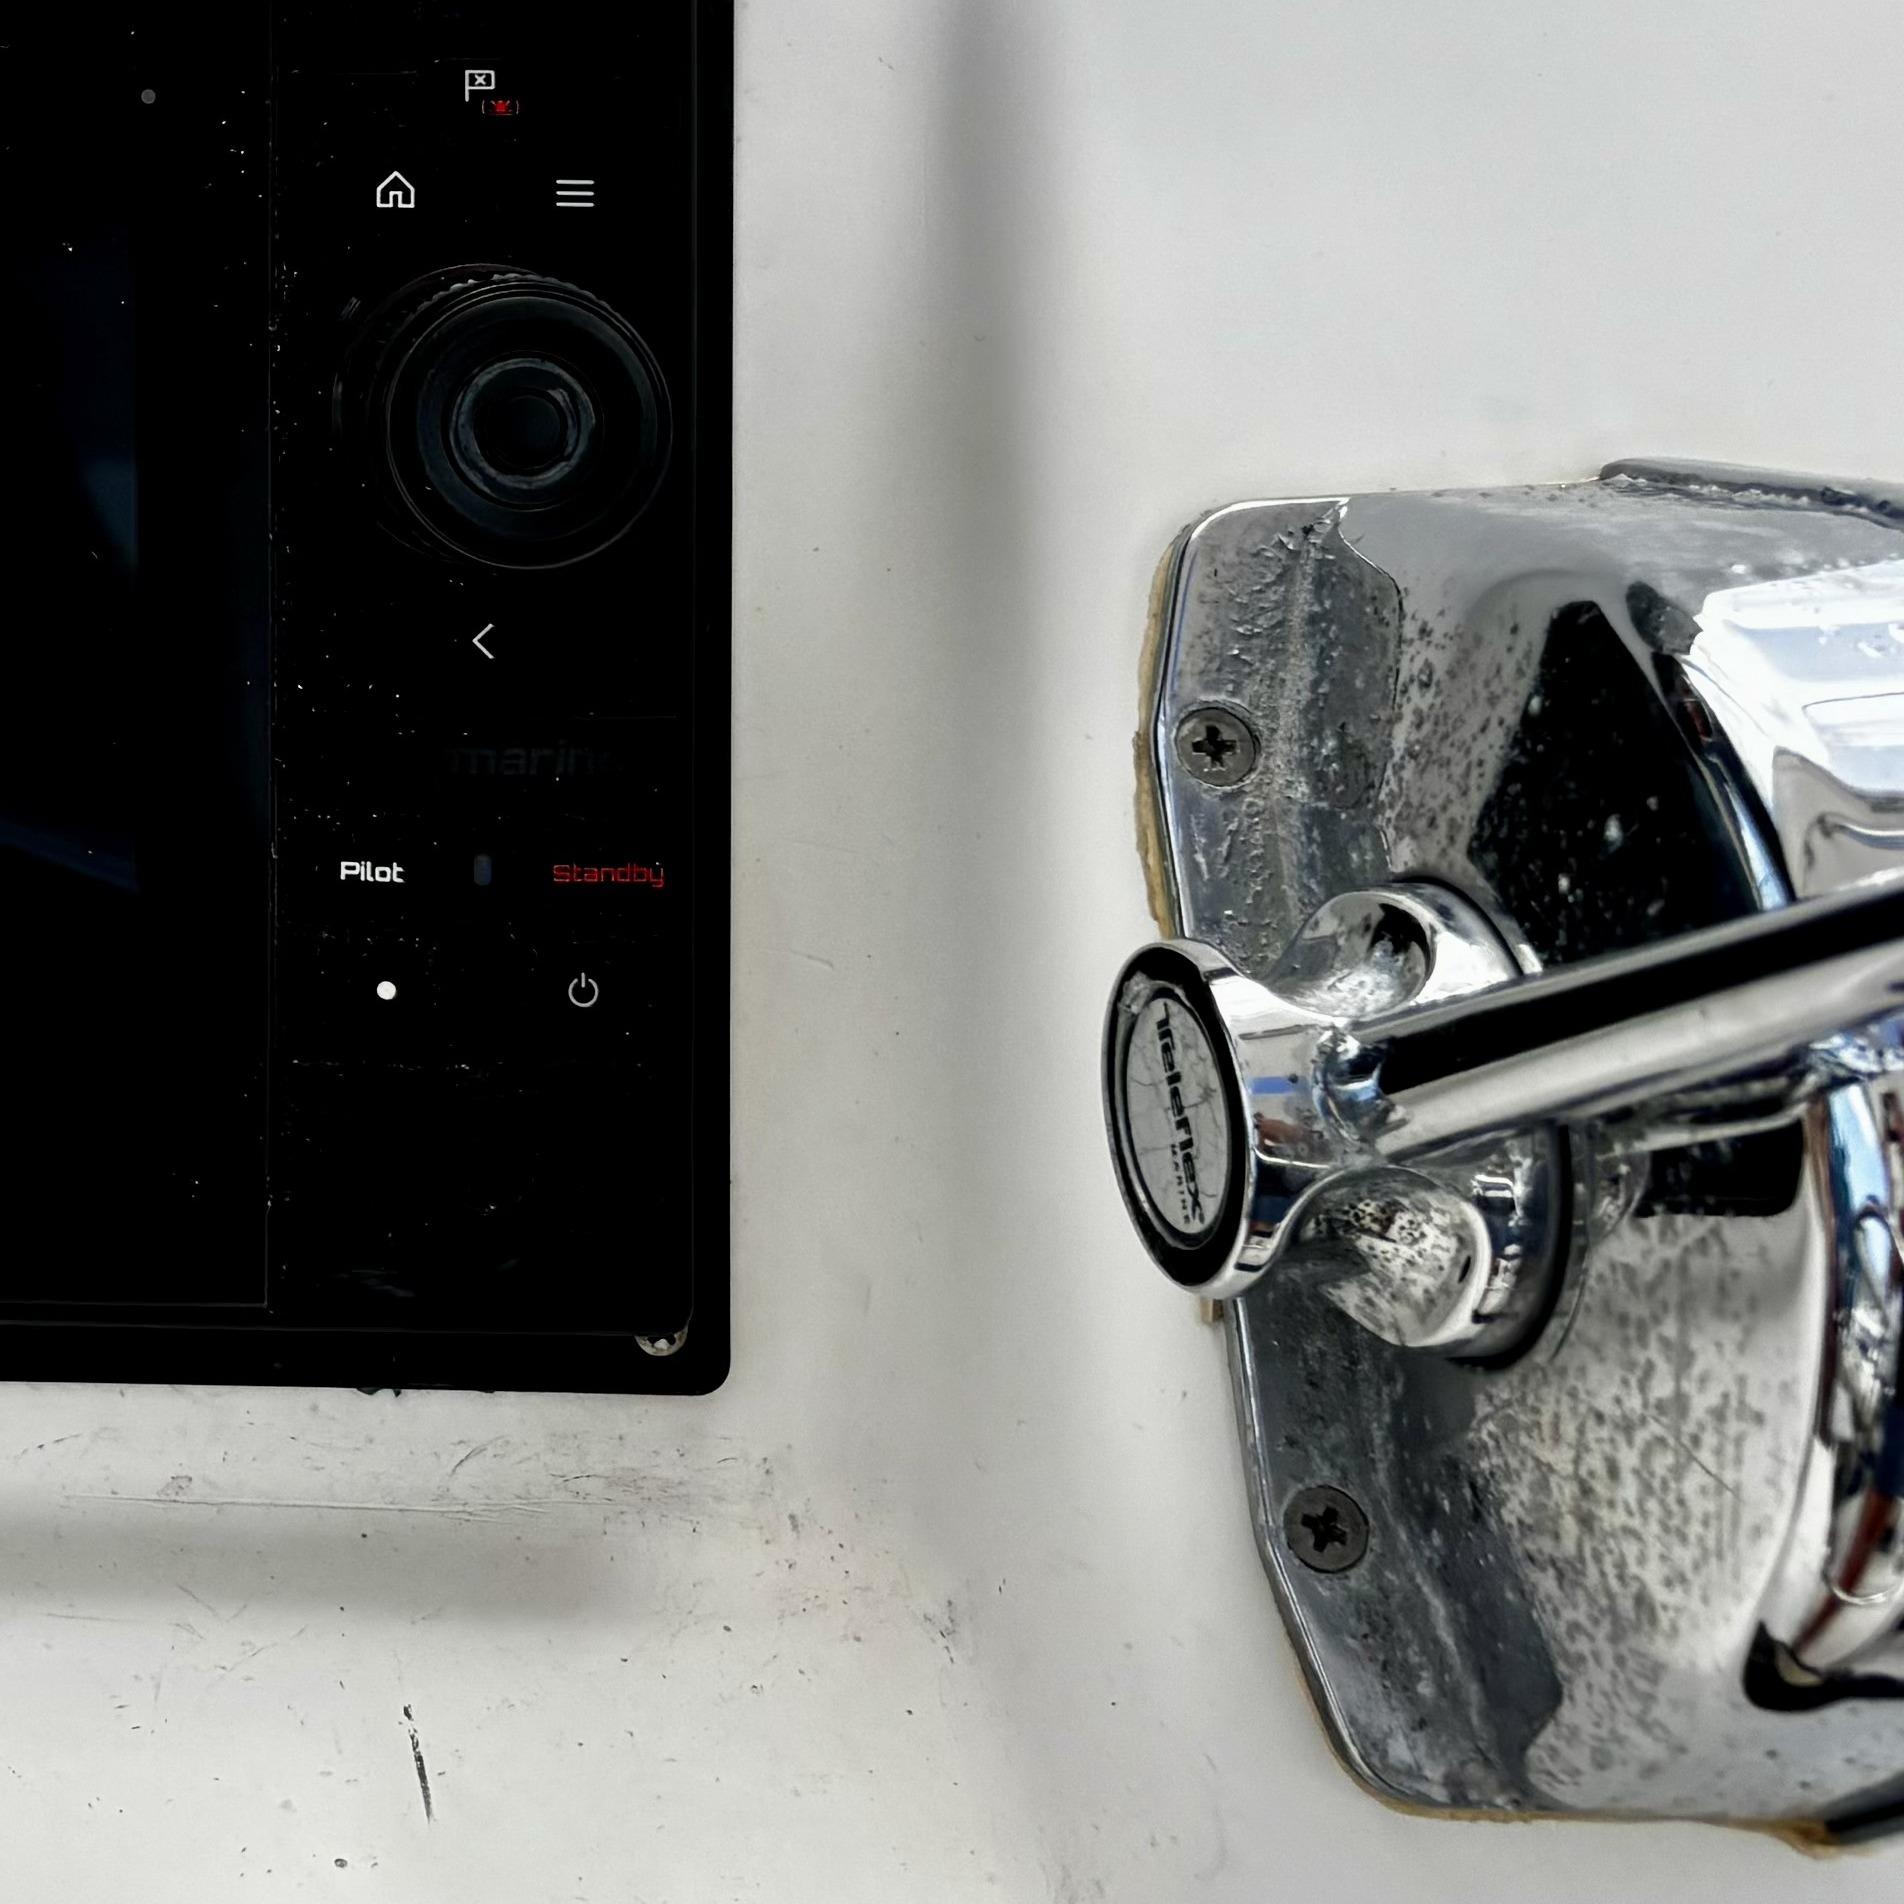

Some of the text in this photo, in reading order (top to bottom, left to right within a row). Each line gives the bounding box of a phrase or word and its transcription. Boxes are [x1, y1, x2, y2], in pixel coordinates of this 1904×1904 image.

[340, 860, 405, 884] Pilot
[552, 862, 665, 889] Standby
[1156, 1001, 1205, 1225] Teleflex
